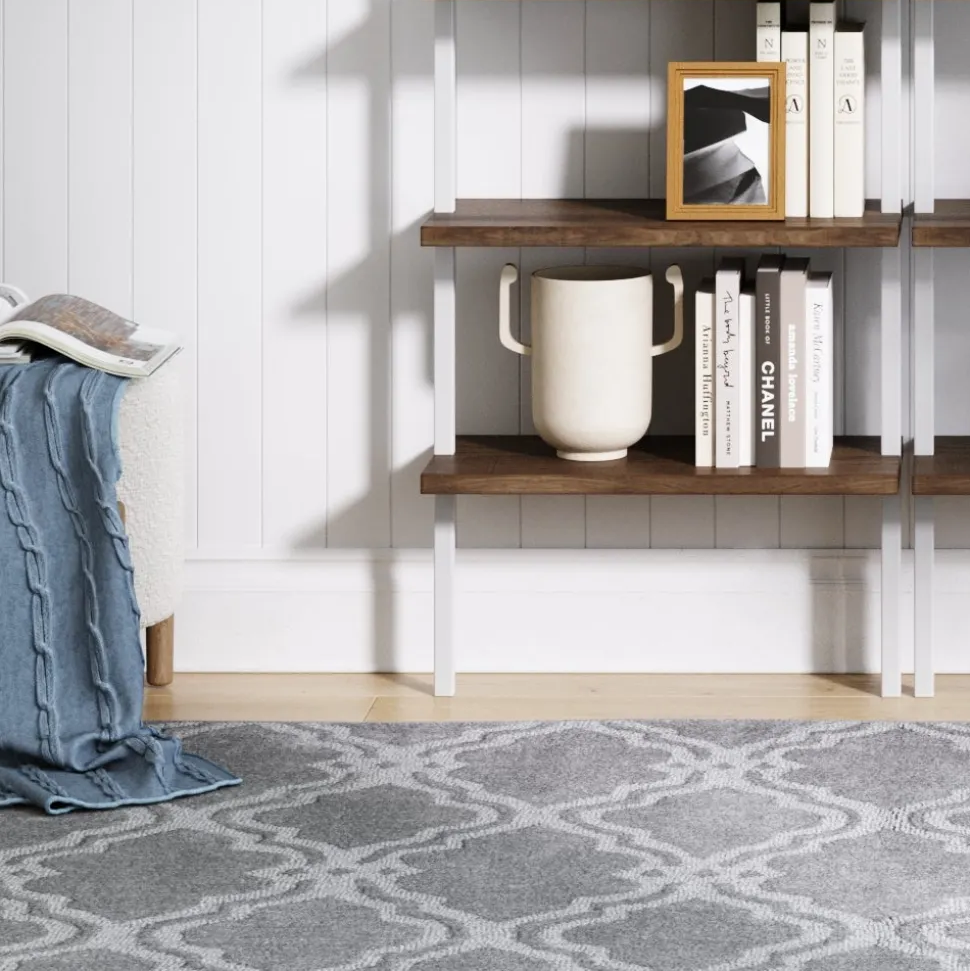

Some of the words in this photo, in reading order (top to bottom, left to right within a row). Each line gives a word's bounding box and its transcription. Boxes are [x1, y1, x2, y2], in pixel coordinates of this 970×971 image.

[764, 335, 771, 345] OF
[813, 303, 822, 332] Karen
[702, 325, 712, 368] Arianna
[788, 324, 797, 370] amanda
[812, 334, 822, 383] McCartney
[701, 374, 713, 436] Huffington
[761, 361, 776, 441] CHANEL
[788, 373, 797, 422] lovelace
